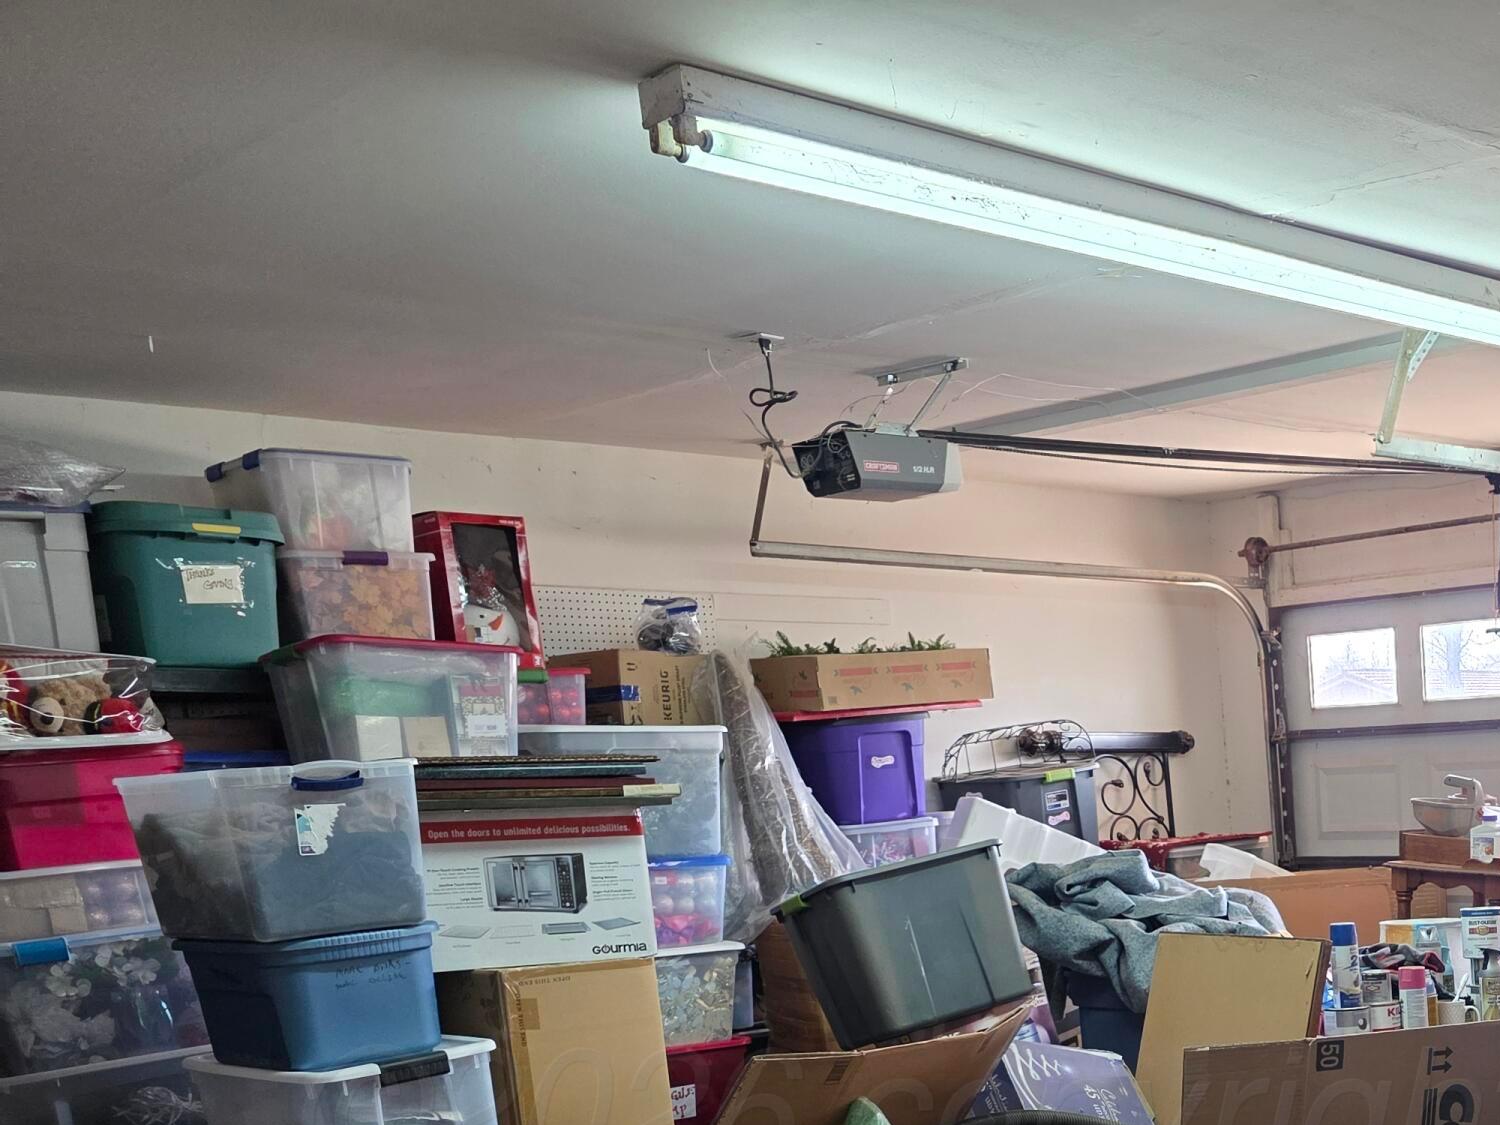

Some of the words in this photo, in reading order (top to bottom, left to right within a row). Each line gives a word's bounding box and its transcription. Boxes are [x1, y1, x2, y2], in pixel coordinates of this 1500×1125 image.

[661, 670, 673, 721] KEURIG
[428, 830, 449, 839] Open
[451, 829, 465, 838] the
[467, 828, 490, 837] doors
[504, 825, 541, 835] unlimited
[544, 825, 579, 834] delicious
[582, 823, 630, 834] possibilities.
[1320, 1044, 1340, 1068] 50
